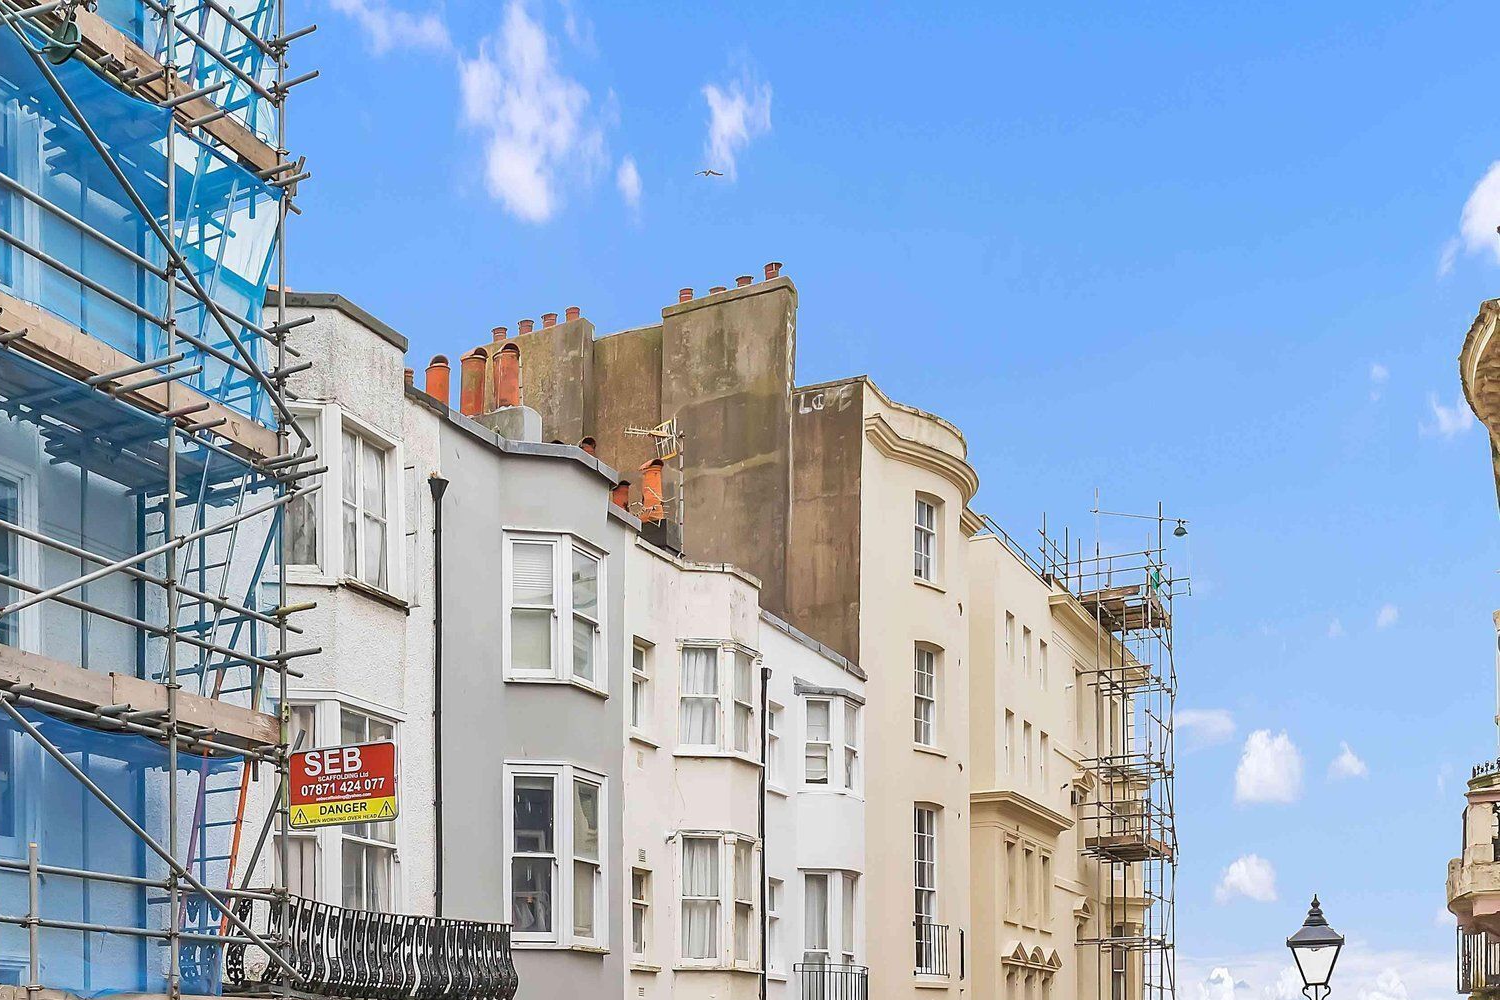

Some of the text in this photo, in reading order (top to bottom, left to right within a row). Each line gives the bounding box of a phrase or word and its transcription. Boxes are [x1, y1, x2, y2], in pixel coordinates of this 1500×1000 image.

[304, 747, 362, 776] SEB
[318, 773, 358, 782] SCAFFOLDING
[301, 778, 385, 796] 07871 424 077
[320, 802, 367, 815] DANGER
